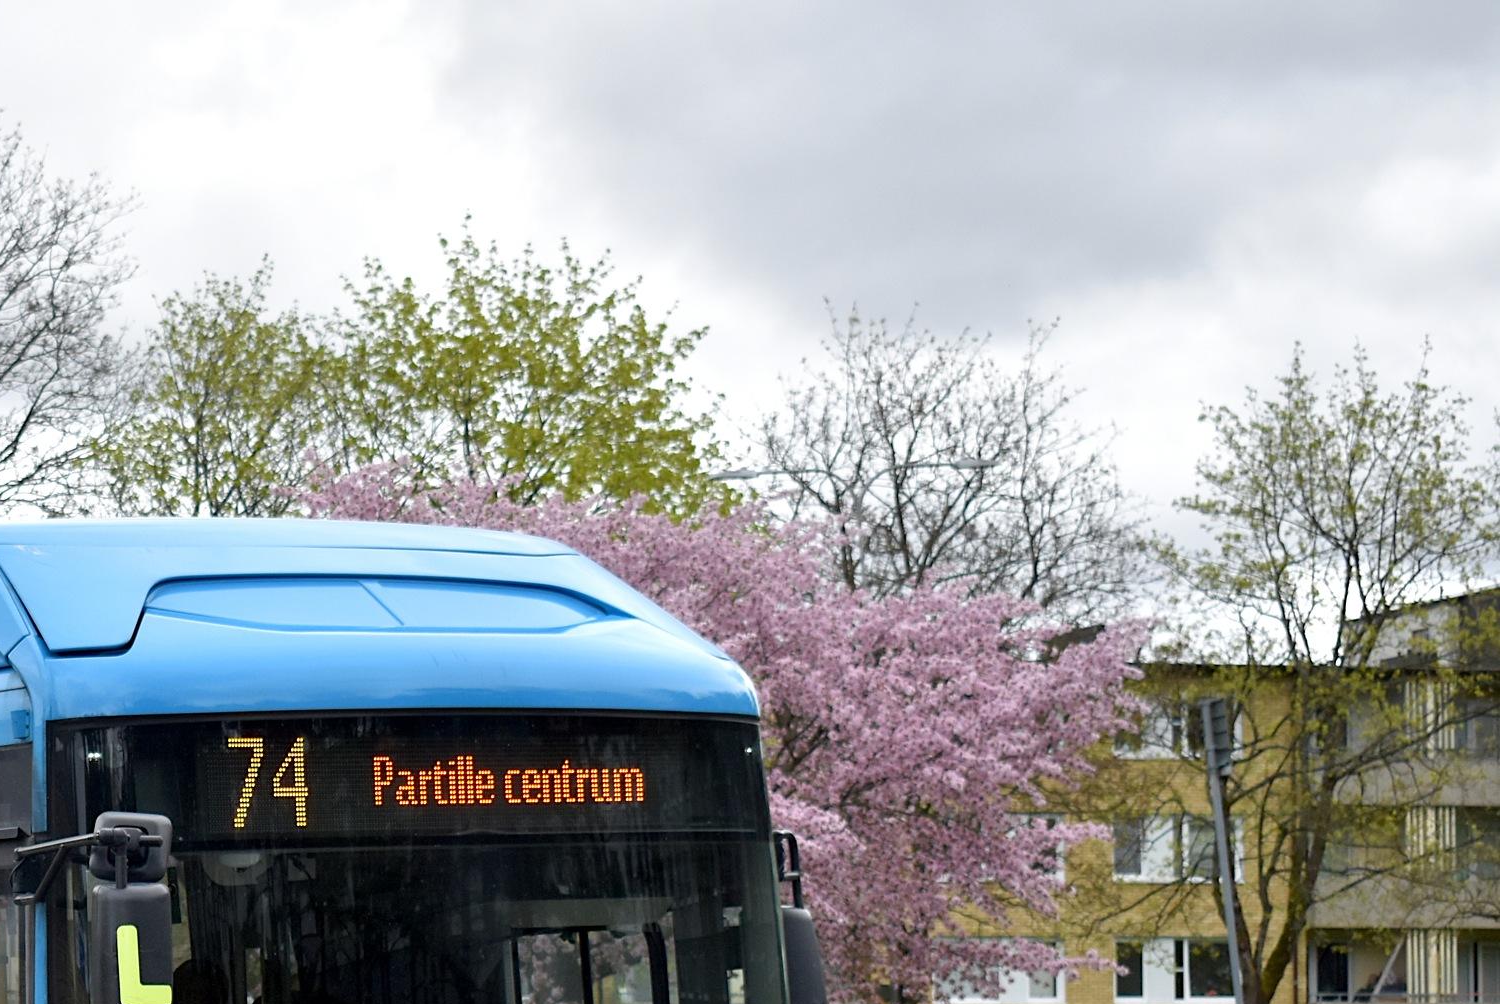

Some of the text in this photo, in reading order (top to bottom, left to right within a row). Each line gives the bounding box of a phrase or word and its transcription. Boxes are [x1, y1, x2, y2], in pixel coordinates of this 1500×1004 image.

[227, 736, 645, 828] 74 Partille centrum
